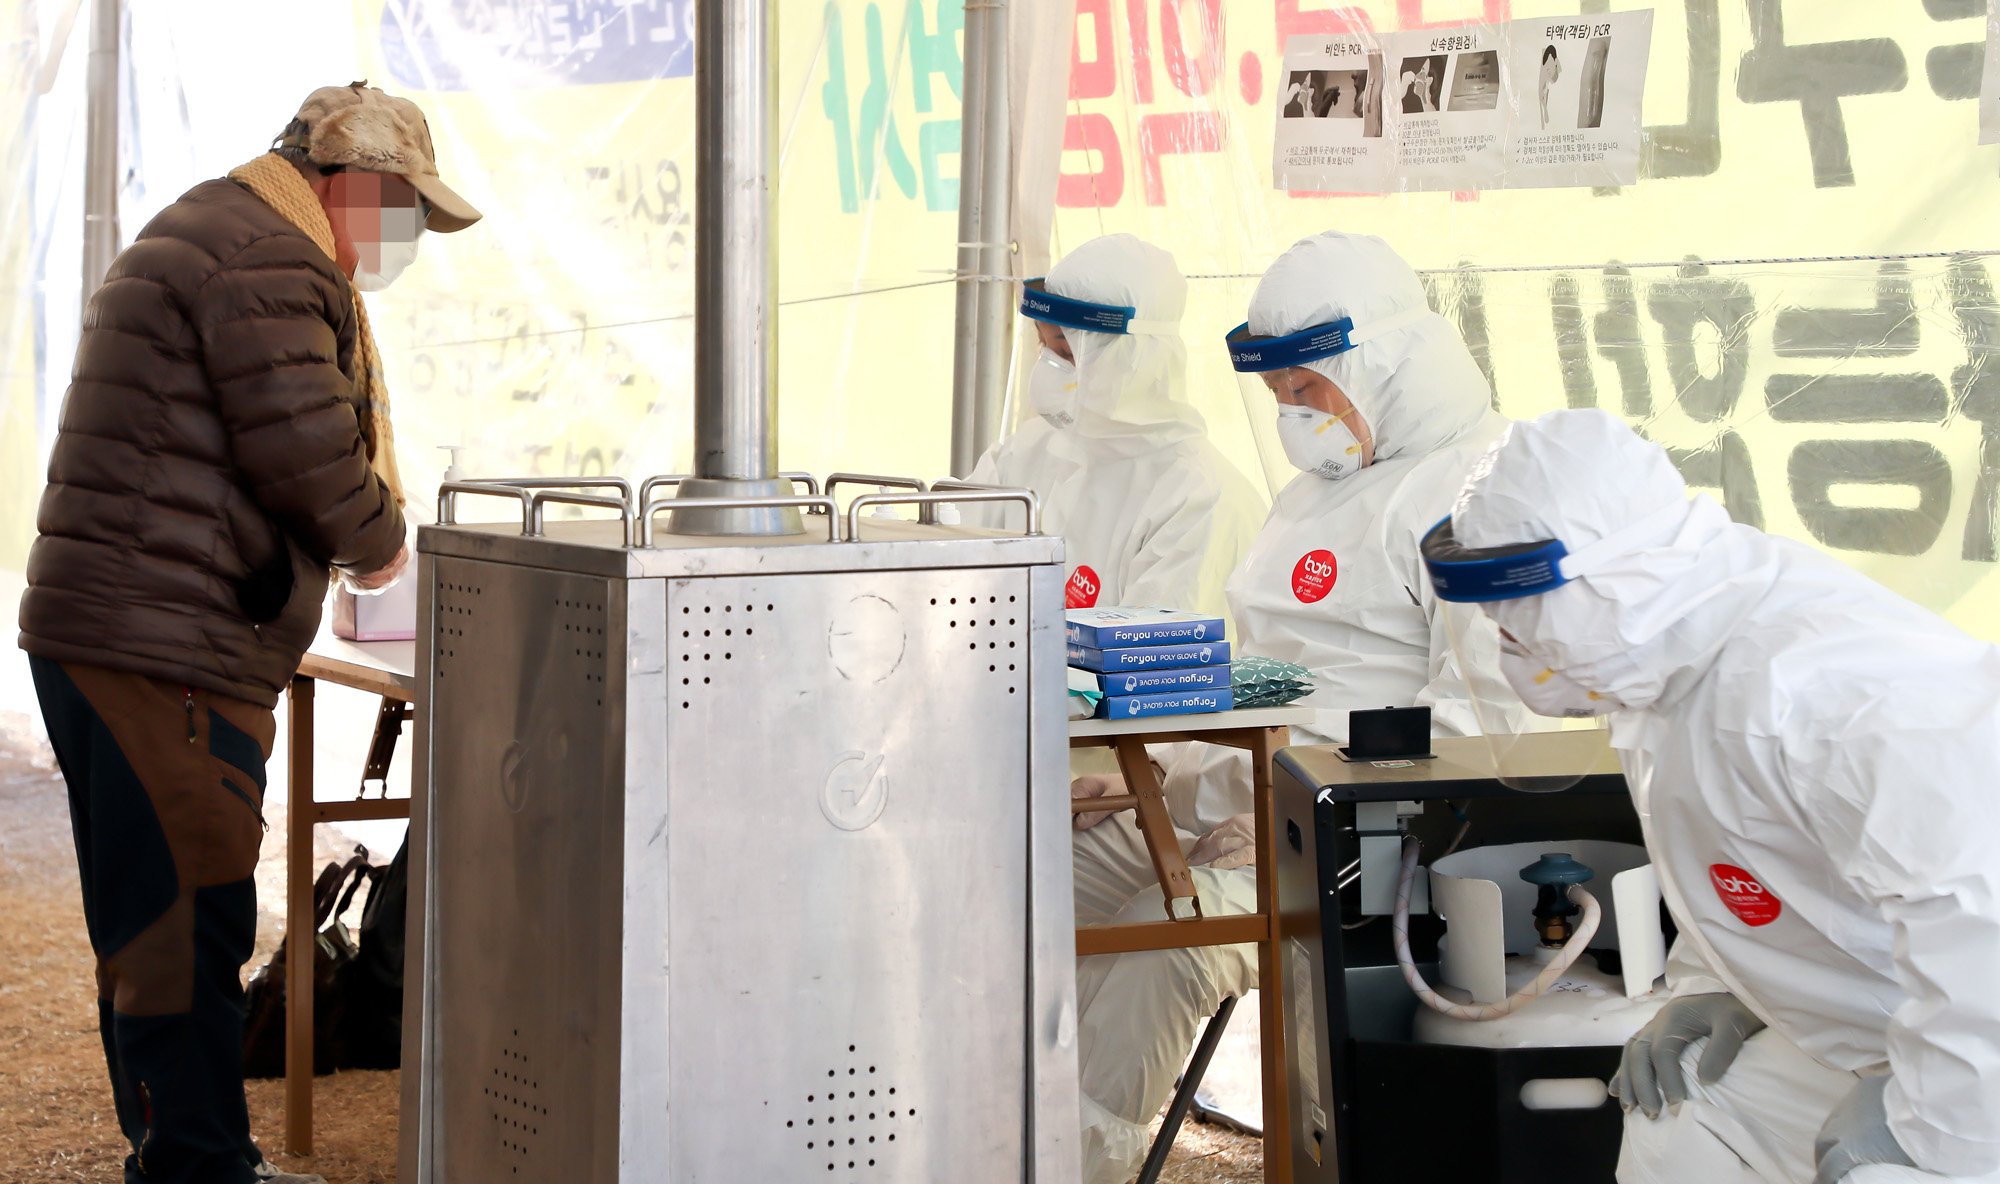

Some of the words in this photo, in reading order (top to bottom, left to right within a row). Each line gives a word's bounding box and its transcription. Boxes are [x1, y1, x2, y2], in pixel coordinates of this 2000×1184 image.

[1593, 23, 1611, 36] PCR
[1325, 44, 1346, 56] 비인두
[1348, 44, 1362, 55] PCR
[1030, 300, 1051, 313] Shield
[1241, 352, 1262, 362] Shield
[1171, 628, 1192, 637] GLOVE
[1177, 651, 1198, 660] GLOVE
[1139, 678, 1159, 686] GLOVE
[1159, 677, 1176, 685] POLY
[1142, 702, 1162, 710] GLOVE
